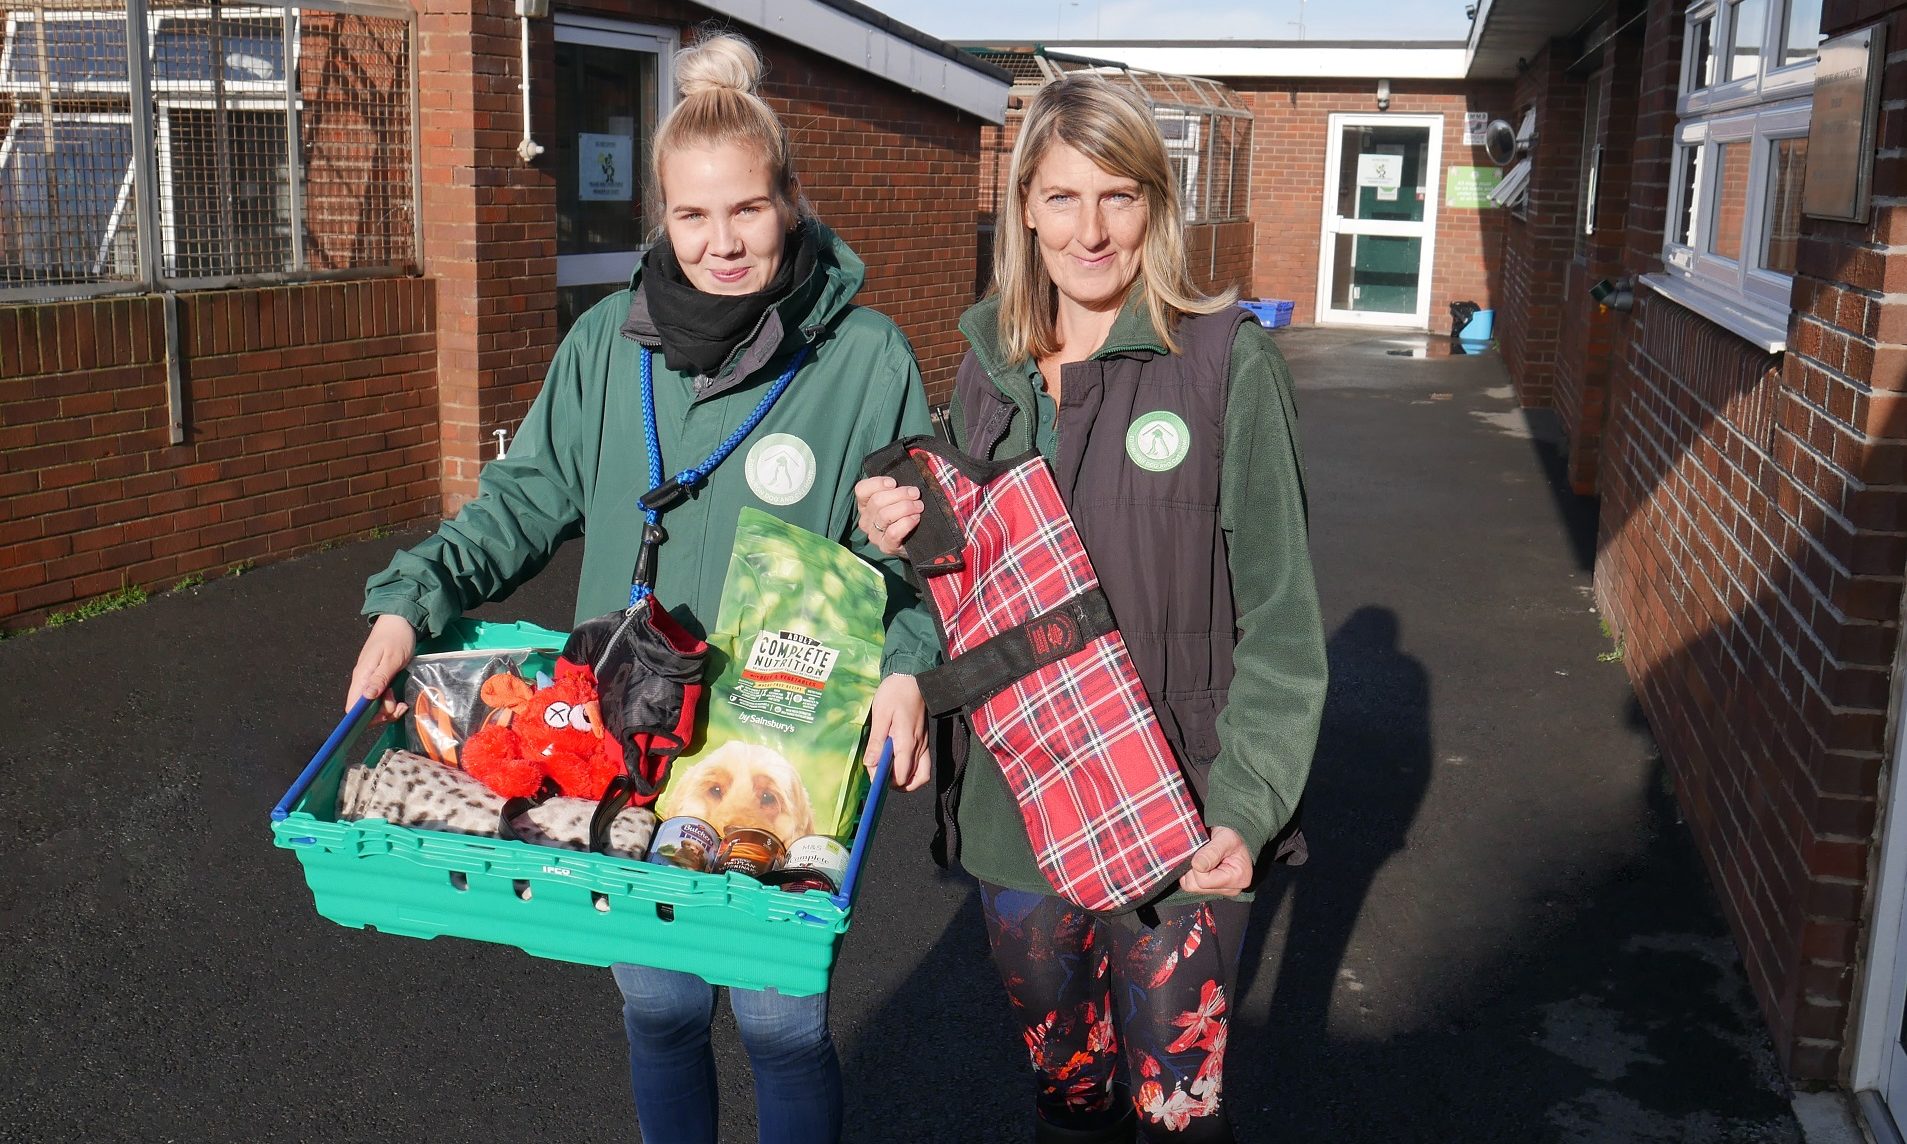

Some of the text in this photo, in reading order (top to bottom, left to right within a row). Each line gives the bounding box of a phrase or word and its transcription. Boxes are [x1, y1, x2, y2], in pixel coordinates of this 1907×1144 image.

[763, 492, 778, 503] DOG
[780, 494, 794, 503] AND
[787, 633, 813, 644] ADULT
[759, 636, 831, 668] COMPLETE
[754, 655, 824, 676] NUTRITION
[780, 674, 817, 687] VEGETABLES
[786, 684, 802, 692] RECIPE
[738, 712, 750, 723] by
[750, 714, 795, 732] Sainsbury's
